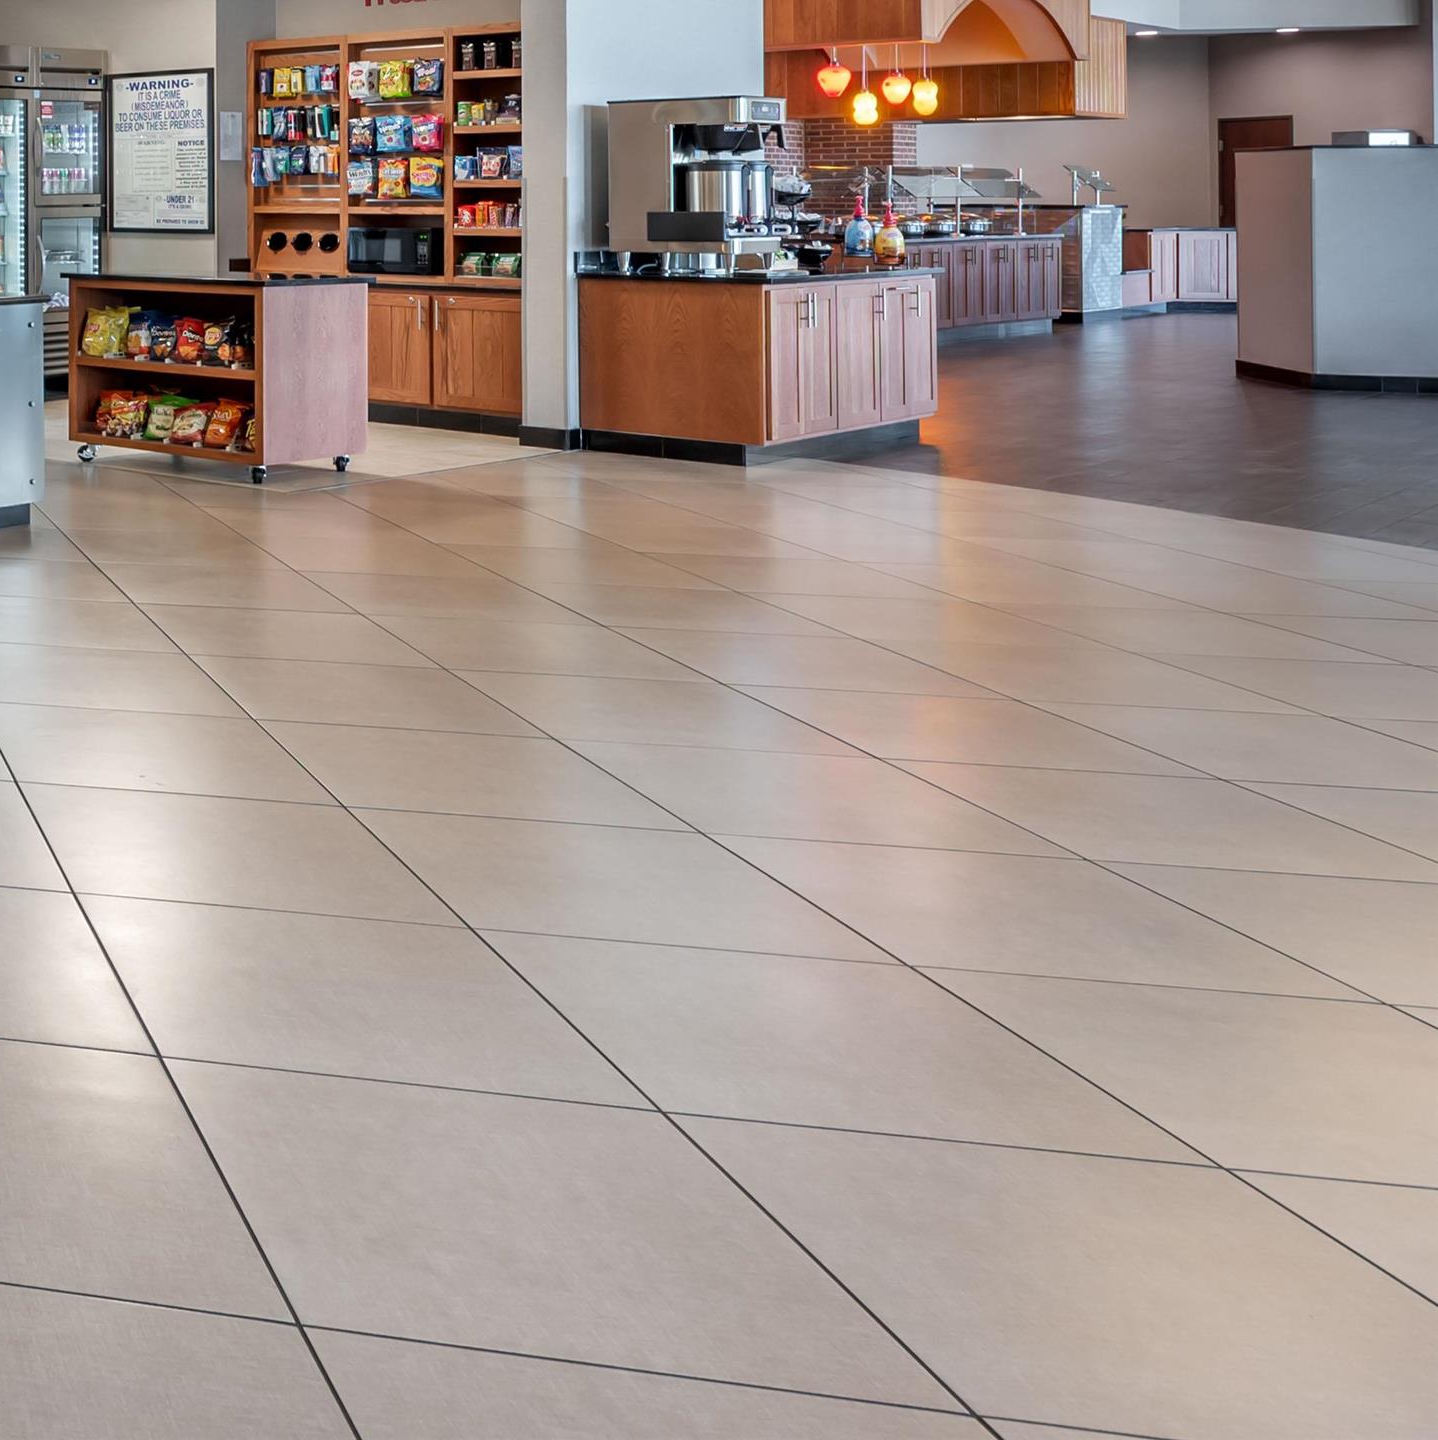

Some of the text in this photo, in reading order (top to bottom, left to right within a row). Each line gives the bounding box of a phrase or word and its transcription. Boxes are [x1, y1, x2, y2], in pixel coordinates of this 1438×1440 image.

[138, 90, 181, 101] IT IS A CRIME
[119, 109, 203, 122] TO CONSUME LIQUOR OR
[115, 123, 133, 133] BEER
[134, 122, 144, 131] ON
[146, 121, 168, 131] THESE
